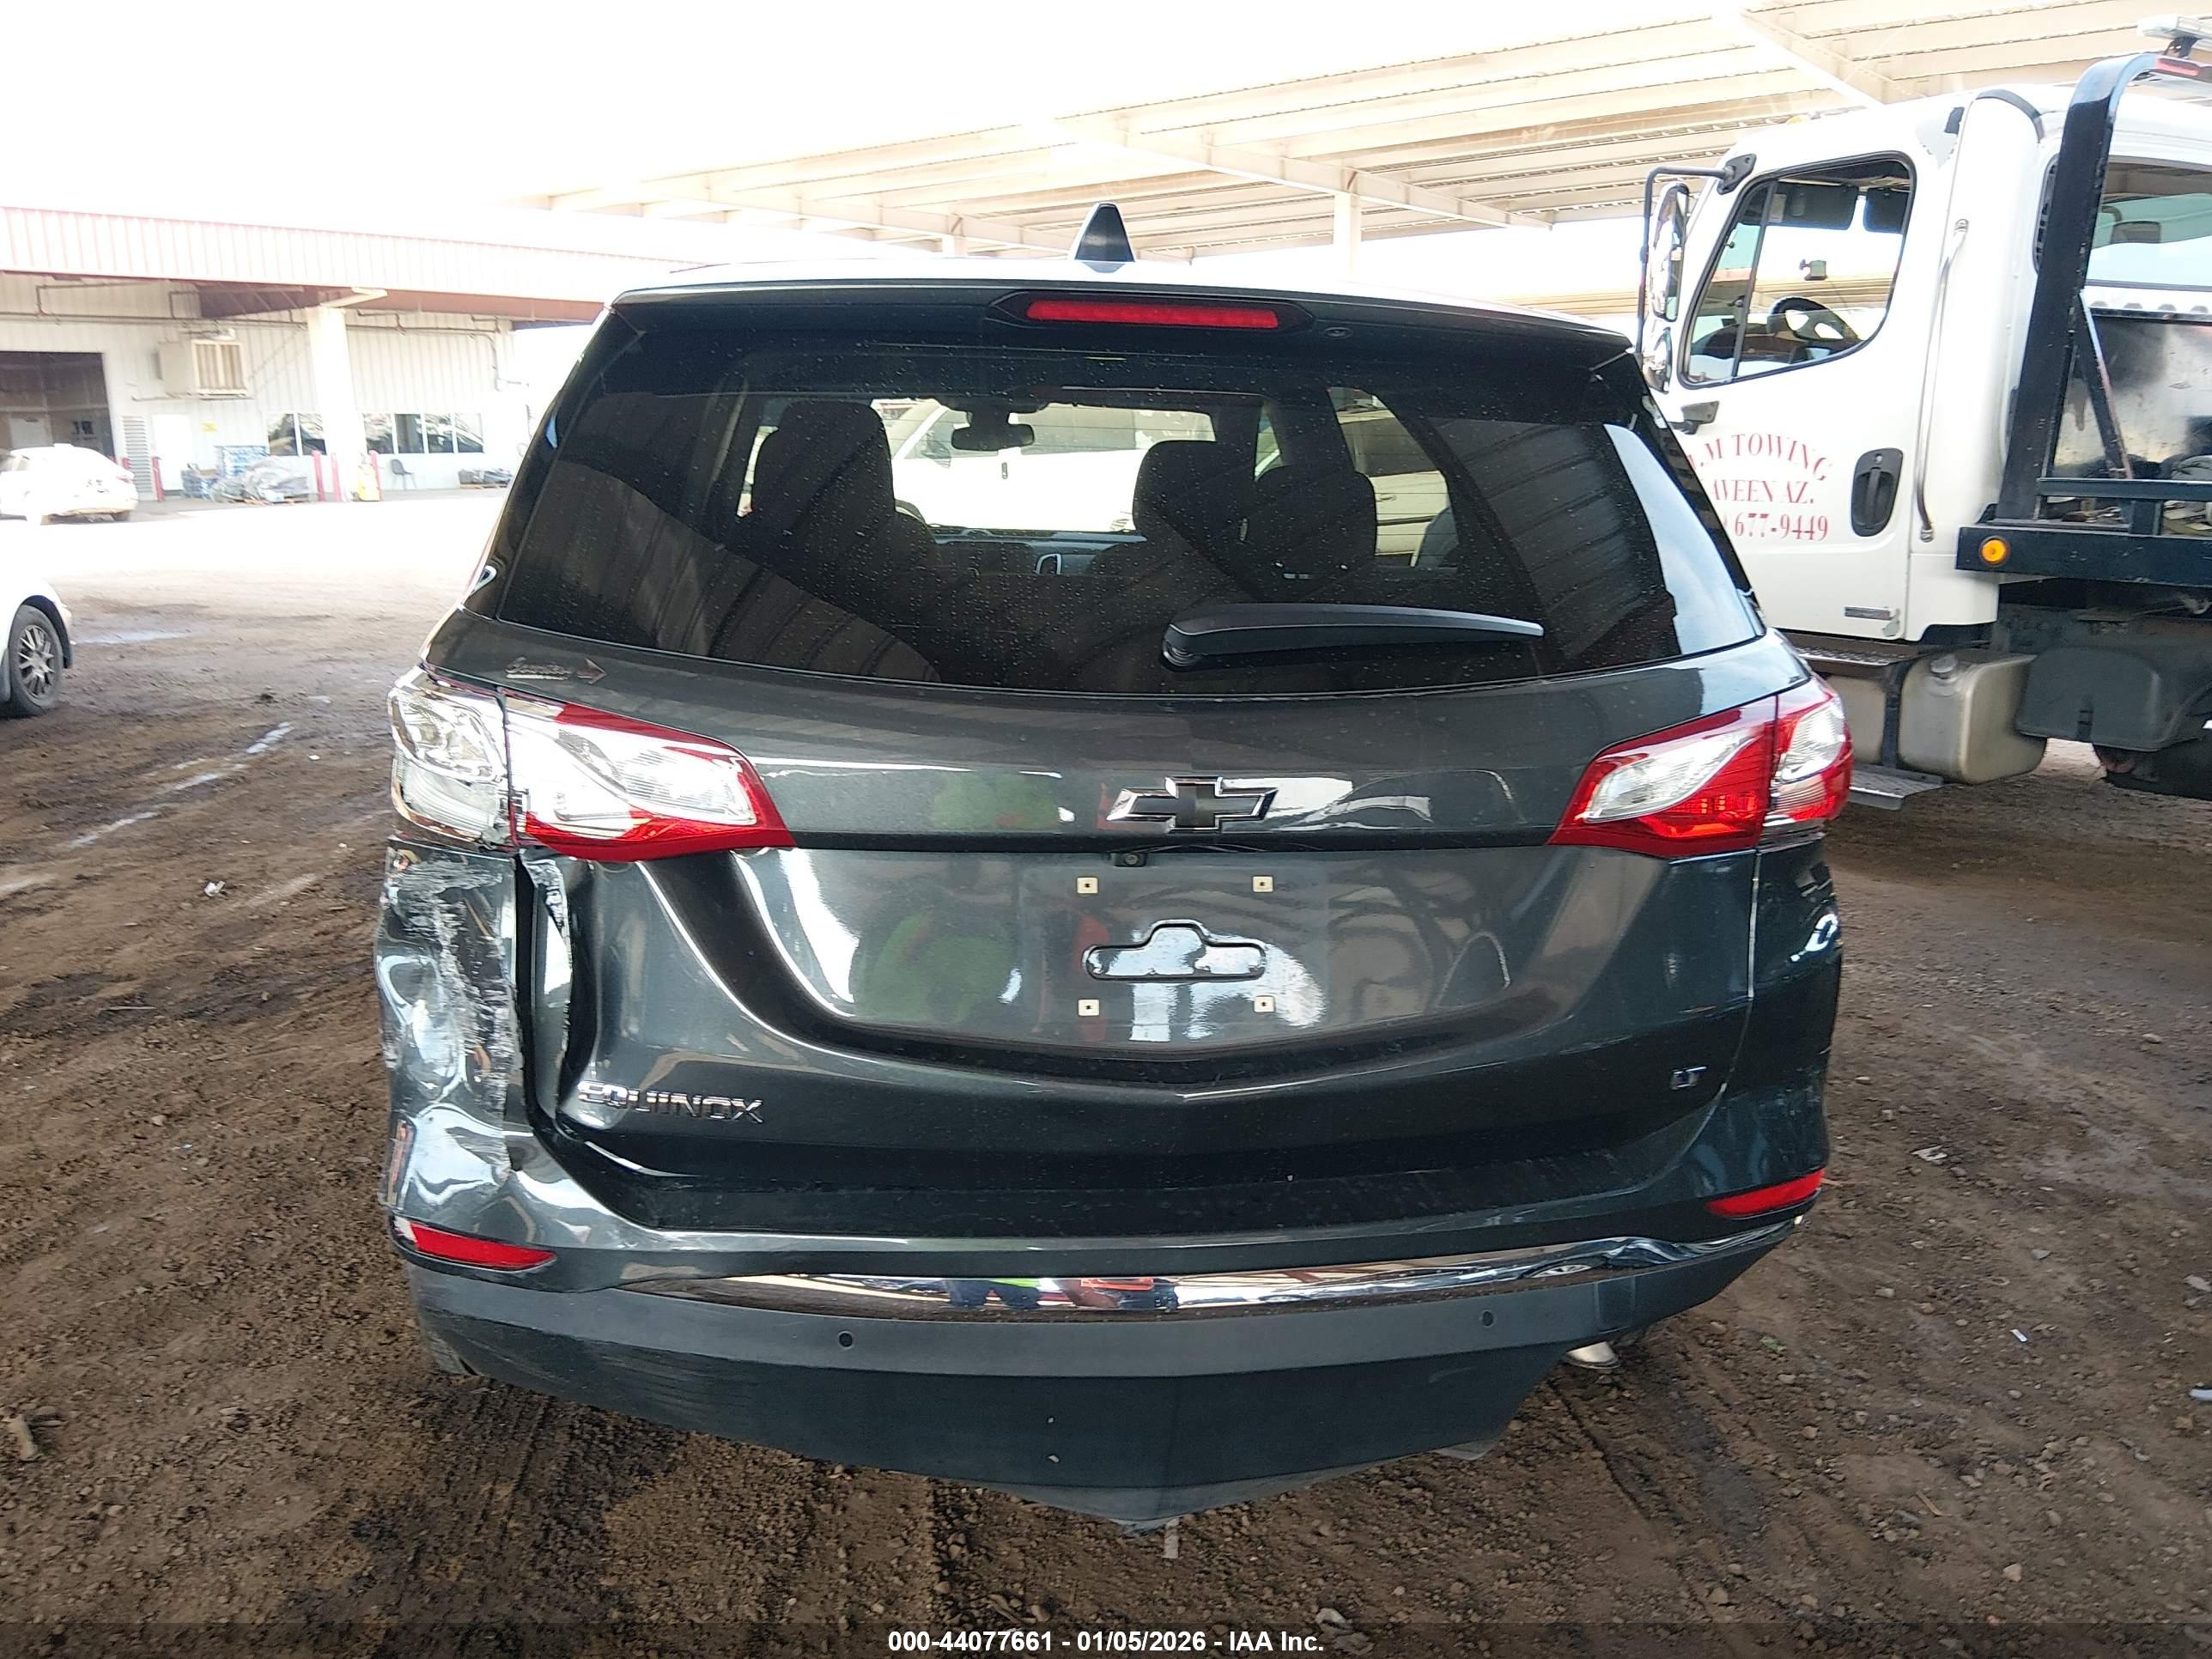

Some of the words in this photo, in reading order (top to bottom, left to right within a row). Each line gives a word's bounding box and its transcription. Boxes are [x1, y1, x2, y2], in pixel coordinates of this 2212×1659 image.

[1731, 433, 1832, 481] TOWING
[1701, 478, 1774, 502] AVEEN
[1780, 480, 1814, 504] AZ.
[1735, 513, 1828, 542] 677-9449
[1670, 1066, 1707, 1090] LT
[577, 1080, 763, 1123] EQUINOX
